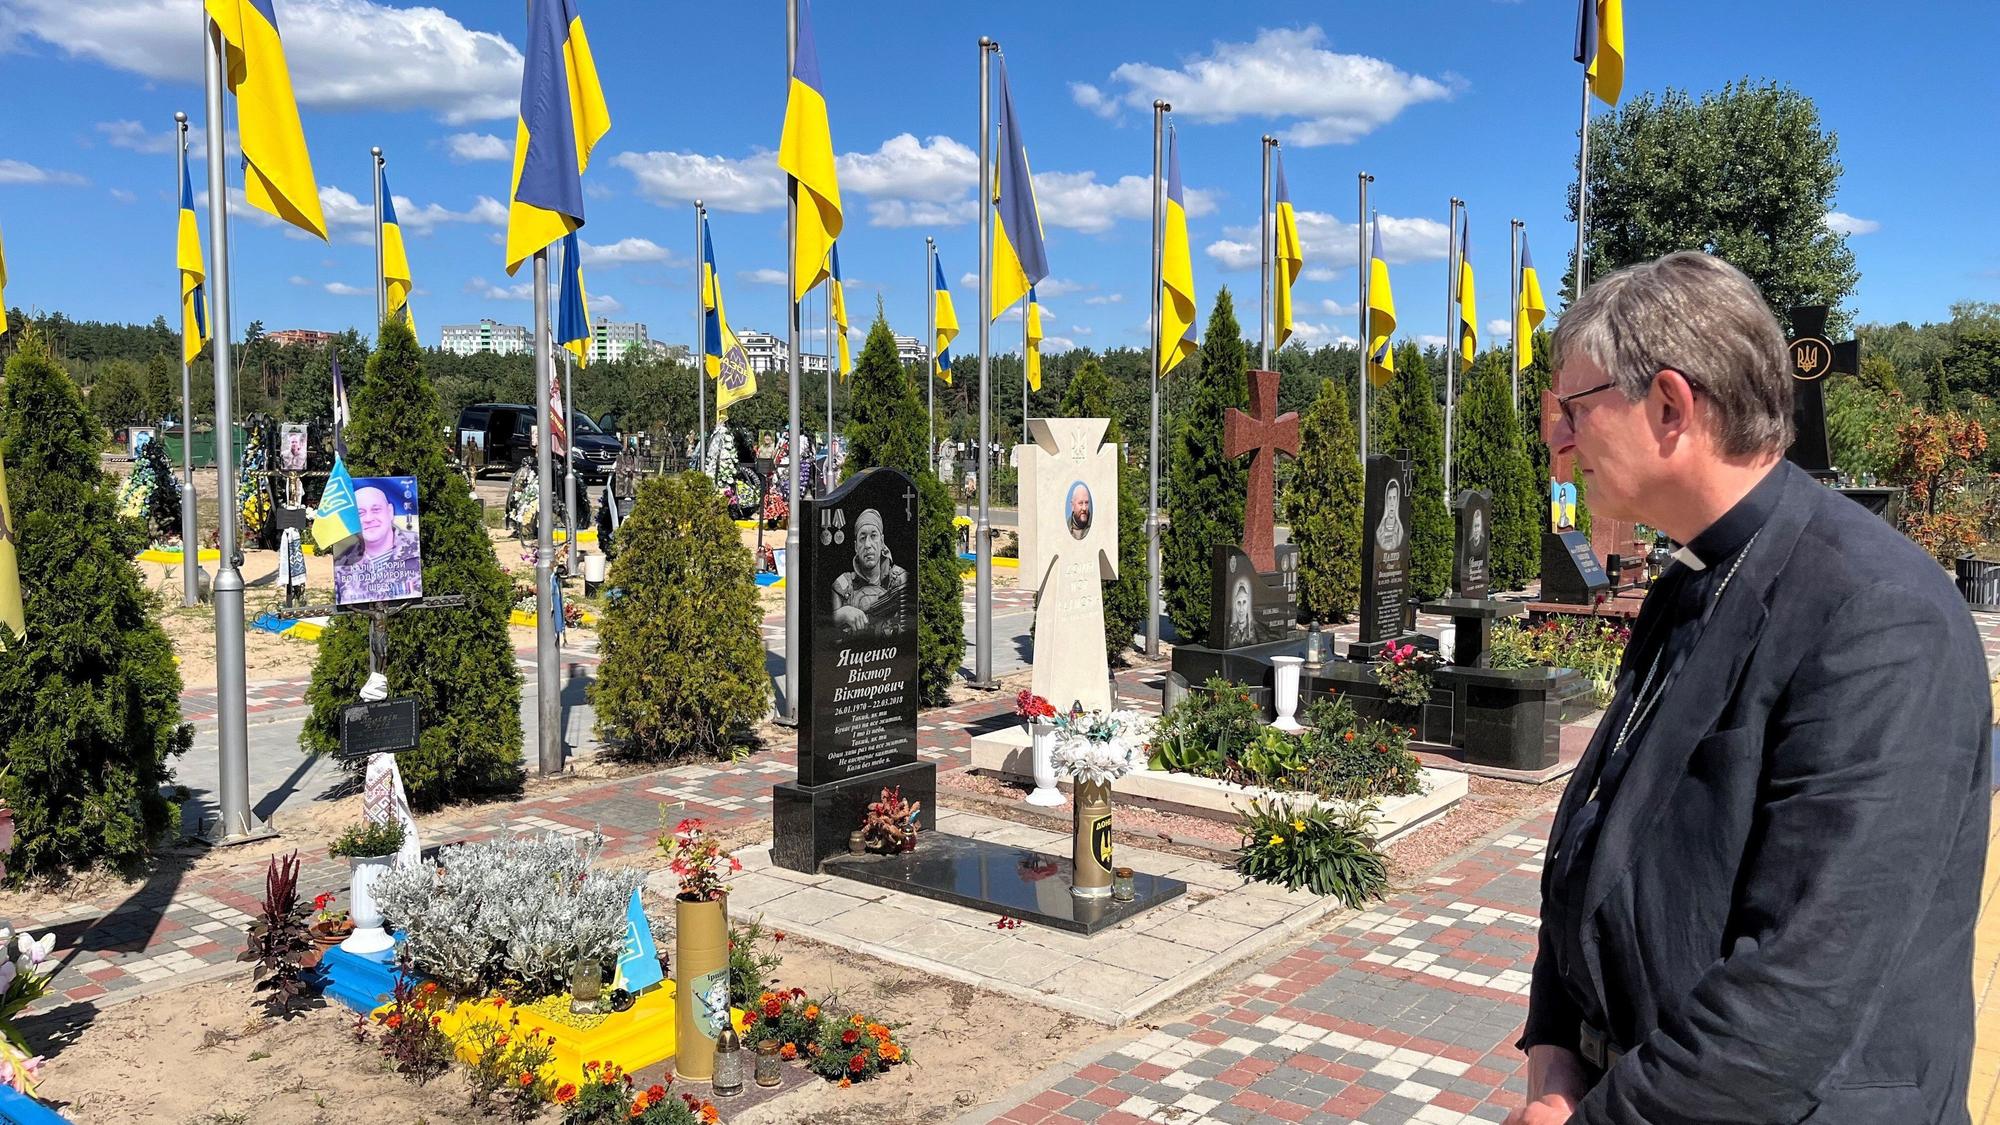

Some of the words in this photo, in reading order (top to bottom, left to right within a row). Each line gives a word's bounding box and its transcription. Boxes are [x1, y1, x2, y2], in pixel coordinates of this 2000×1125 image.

[836, 646, 897, 667] Ященко
[848, 667, 892, 683] Віктор
[833, 680, 904, 703] Вікторович
[834, 703, 867, 716] 26.01.1970
[873, 696, 903, 708] 22.03.2018
